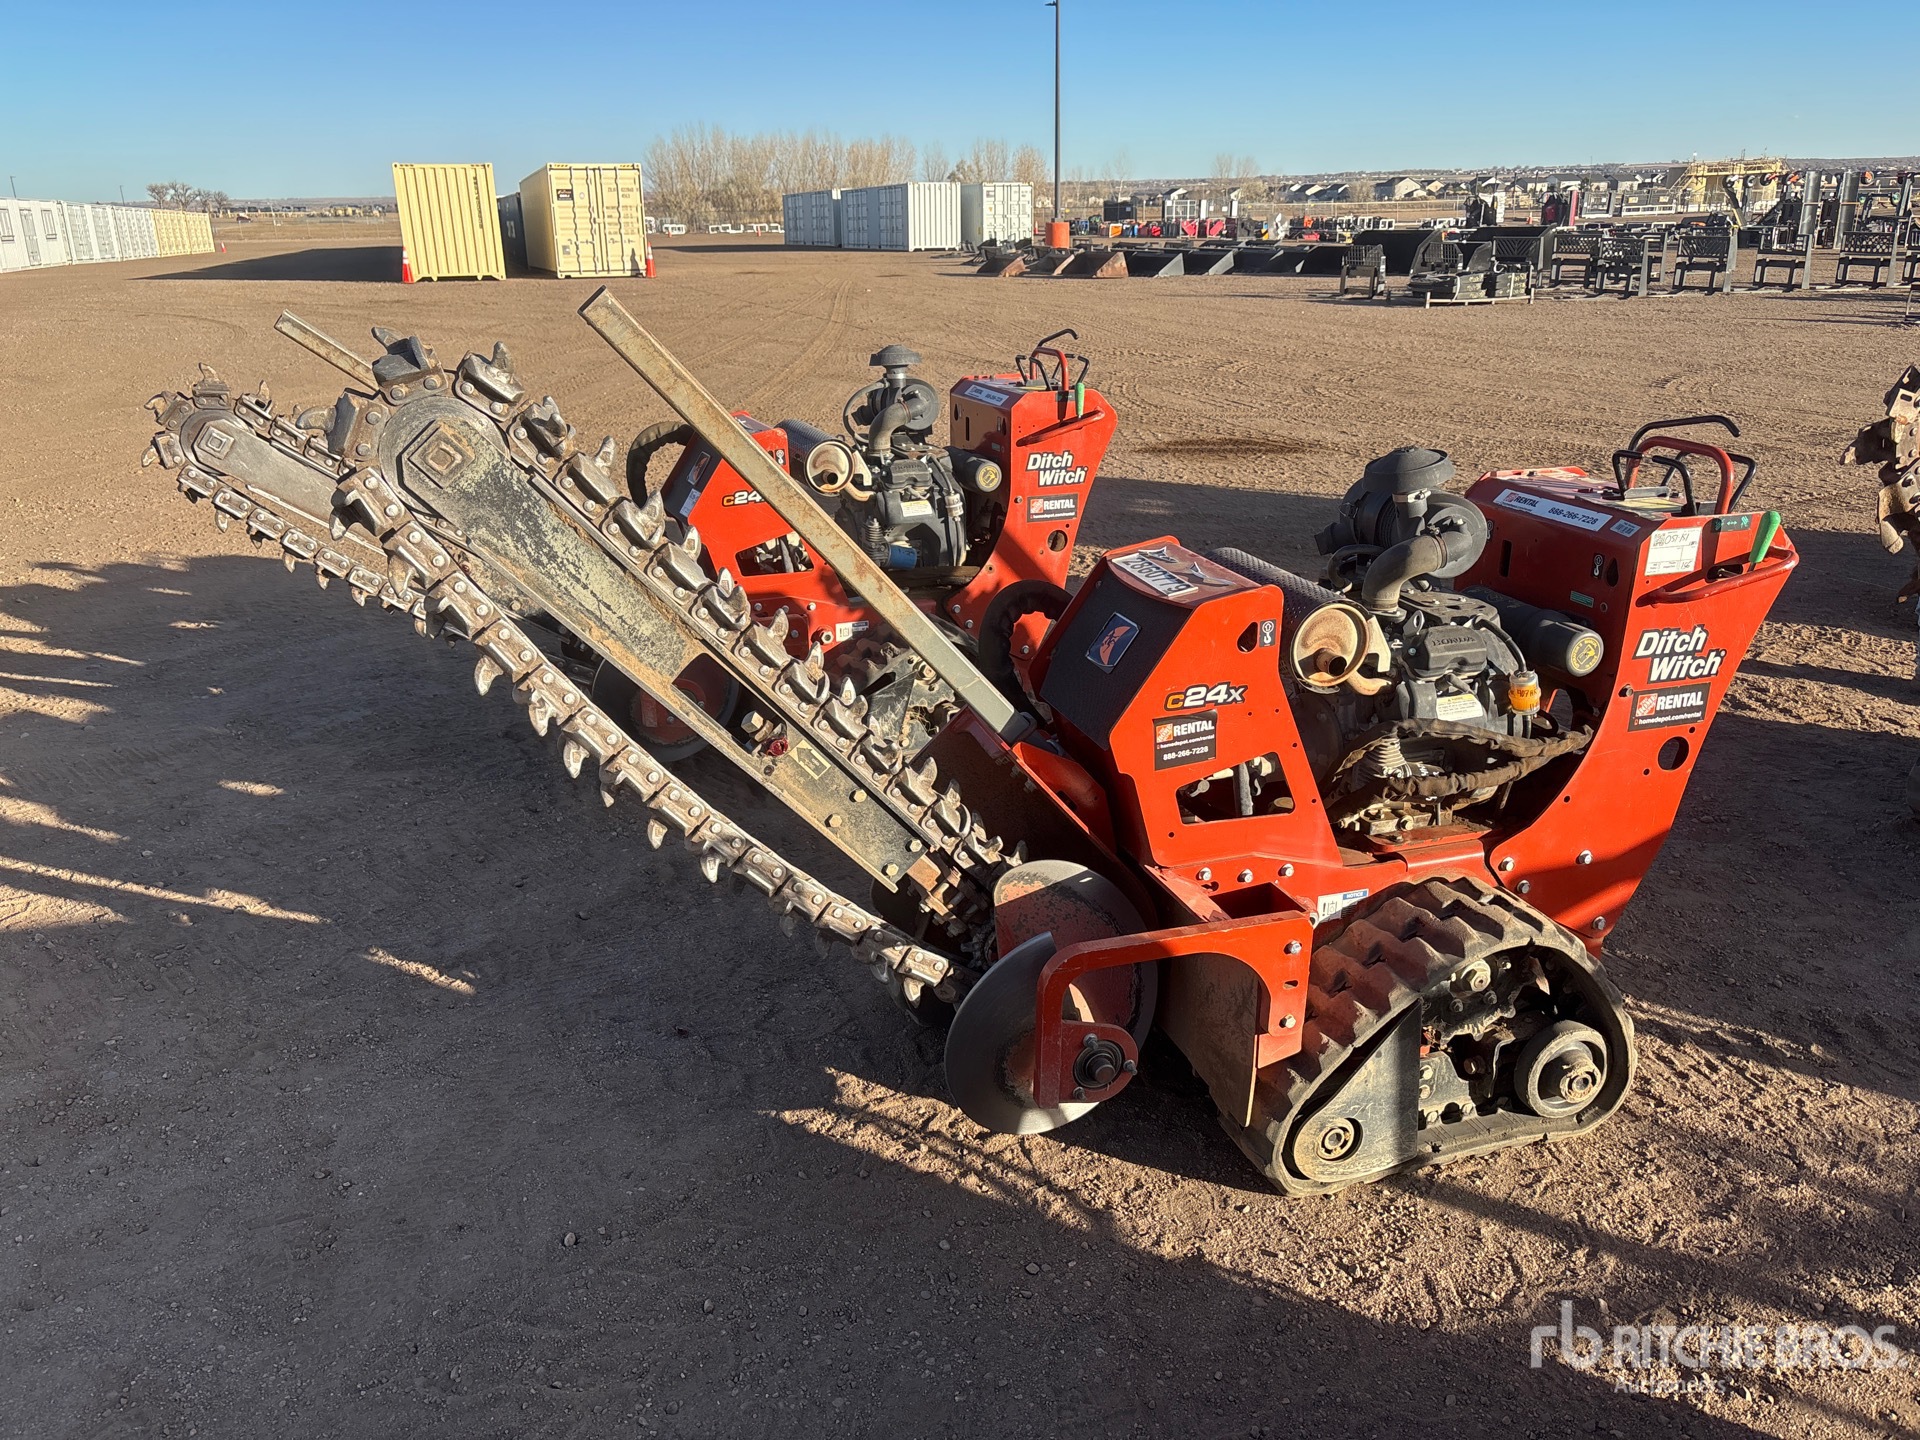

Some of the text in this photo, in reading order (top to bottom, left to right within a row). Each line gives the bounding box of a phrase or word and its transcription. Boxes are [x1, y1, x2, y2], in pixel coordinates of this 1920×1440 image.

[1027, 451, 1073, 470] Ditch
[1039, 467, 1087, 486] Witch
[723, 490, 765, 506] c24
[1043, 499, 1075, 510] RENTAL
[1514, 495, 1538, 508] RENTAL
[1548, 507, 1599, 525] 888-266-7228
[1122, 557, 1192, 594] 2860779
[1635, 626, 1707, 657] Ditch
[1650, 651, 1722, 682] Witch
[1656, 691, 1704, 711] RENTAL
[1638, 711, 1702, 725] homedepot.com/rental
[1173, 720, 1215, 737] RENTAL
